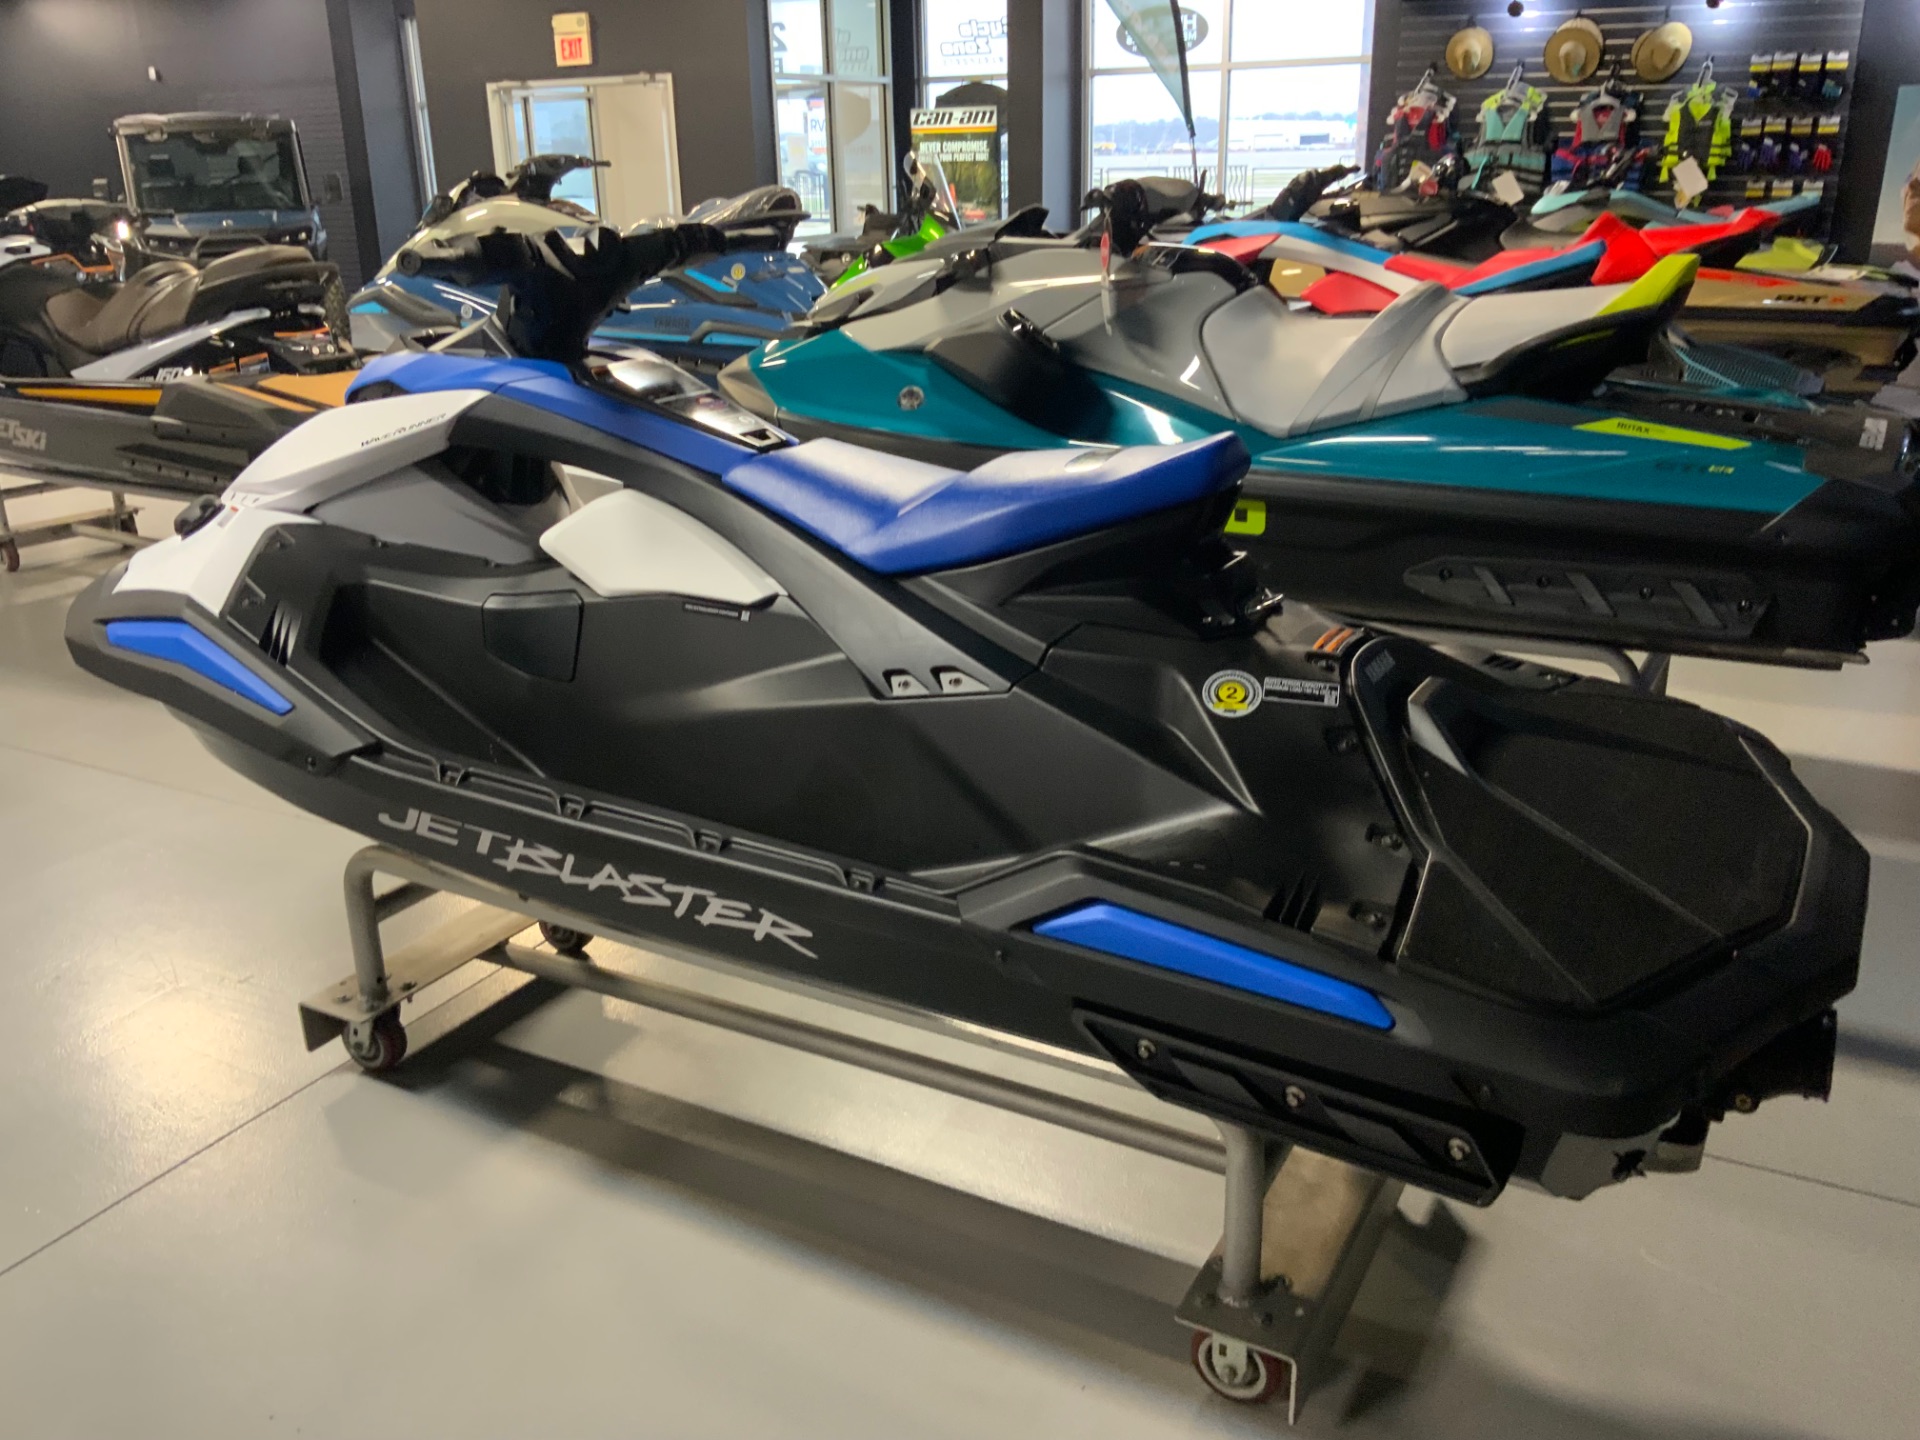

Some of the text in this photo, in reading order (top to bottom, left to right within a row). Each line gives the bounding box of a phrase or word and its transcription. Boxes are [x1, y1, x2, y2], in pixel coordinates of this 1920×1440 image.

[560, 37, 583, 61] EXIT
[913, 110, 995, 126] can-am
[919, 141, 941, 153] NEVER
[1226, 686, 1238, 700] 2
